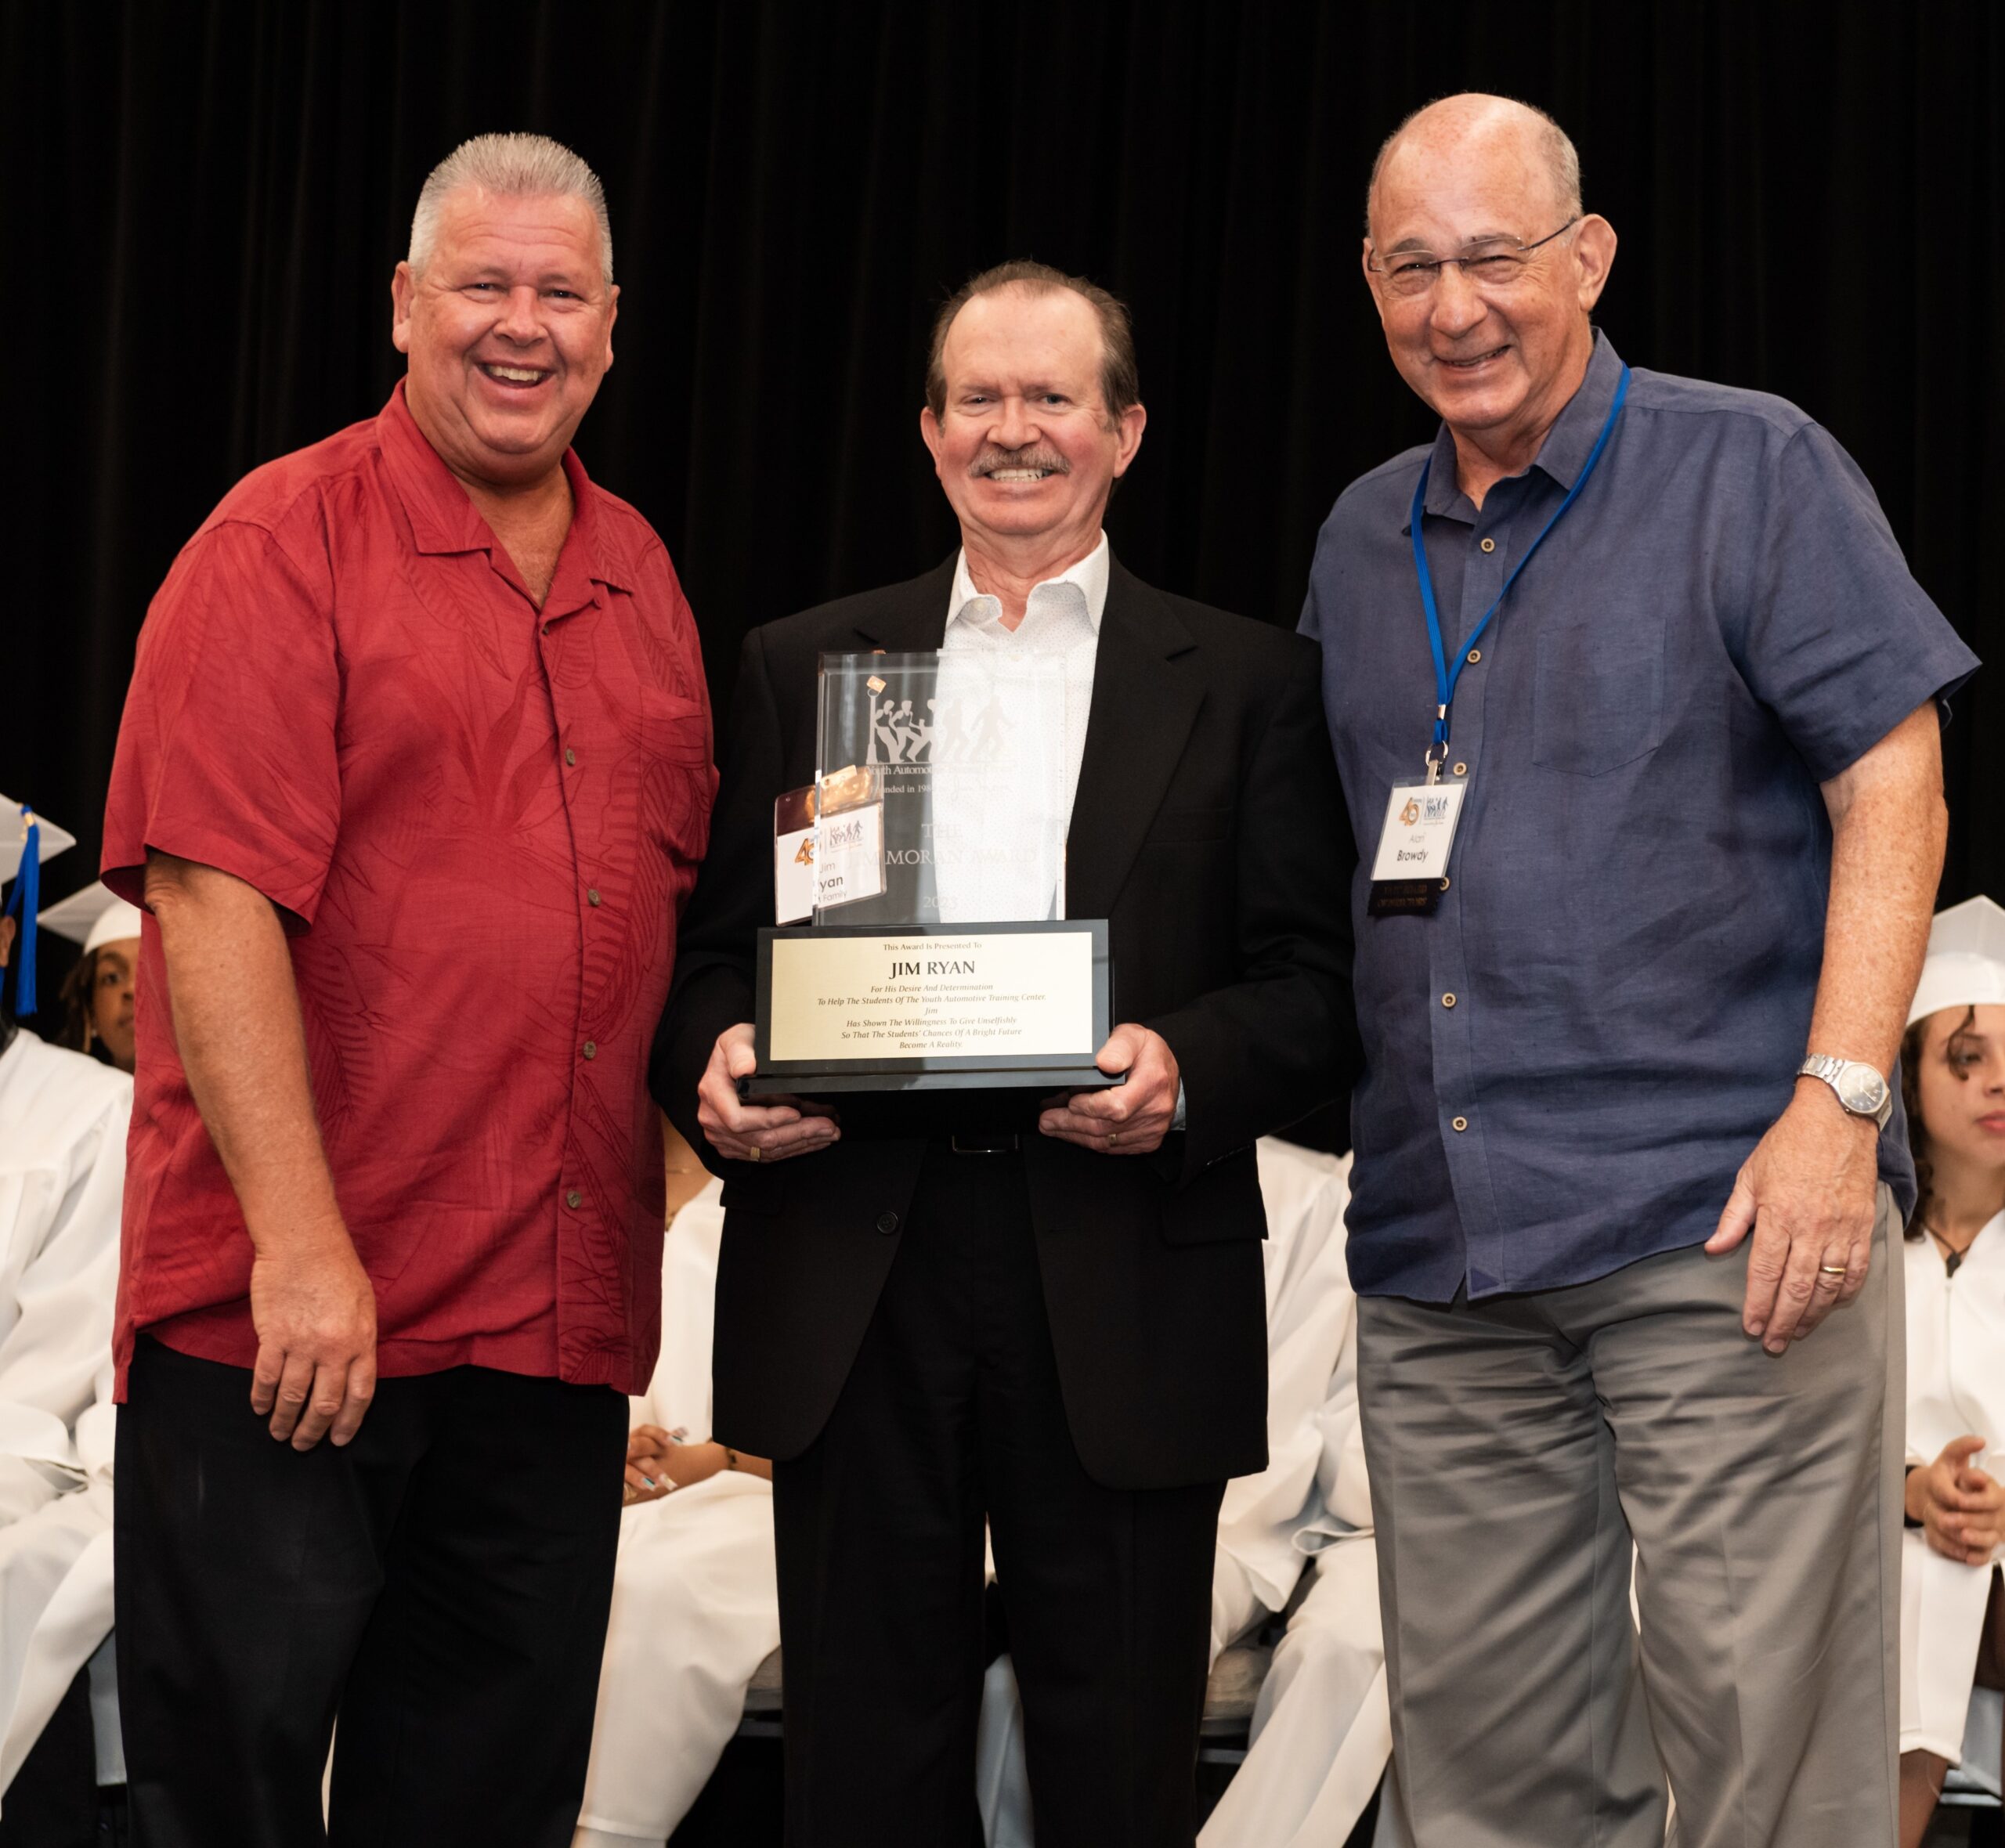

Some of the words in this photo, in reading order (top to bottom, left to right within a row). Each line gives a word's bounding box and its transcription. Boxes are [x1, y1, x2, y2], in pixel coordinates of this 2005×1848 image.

[893, 765, 944, 775] Automot
[907, 784, 915, 793] in
[921, 823, 963, 839] THE
[885, 849, 964, 865] MORAN
[1396, 849, 1429, 864] Browdy
[819, 862, 836, 874] Jim
[815, 875, 844, 893] yan
[822, 890, 848, 902] Family
[888, 962, 920, 980] JIM
[927, 961, 975, 976] RYAN
[828, 998, 844, 1007] Help
[862, 996, 893, 1005] Students
[895, 996, 905, 1005] Of
[988, 994, 1019, 1002] Training
[925, 1007, 938, 1016] Jim
[905, 1018, 947, 1027] Willingness
[977, 1016, 1017, 1026] Unselfishly
[955, 1028, 965, 1038] Of
[973, 1028, 996, 1037] Bright
